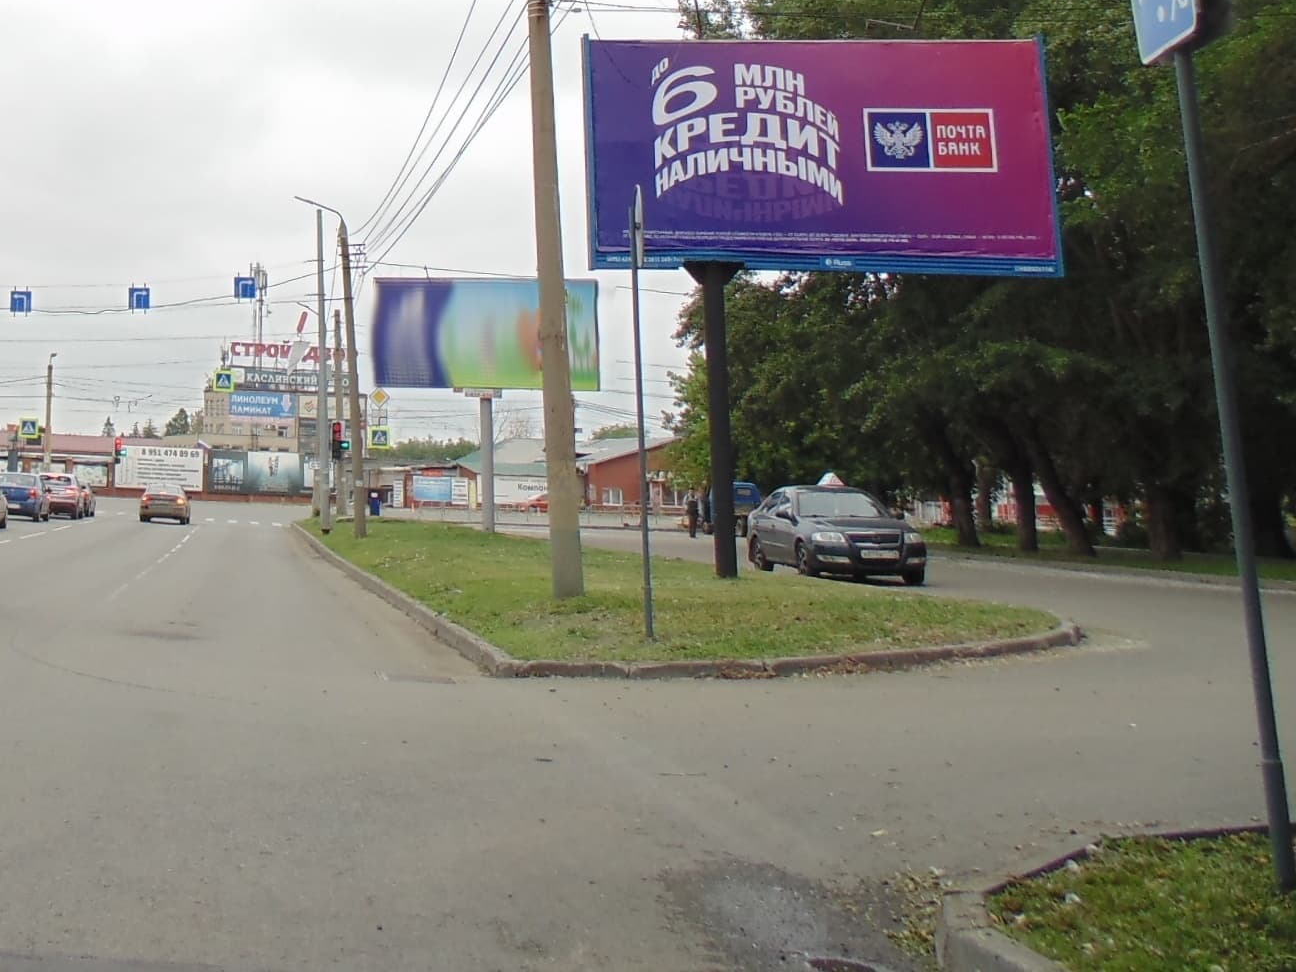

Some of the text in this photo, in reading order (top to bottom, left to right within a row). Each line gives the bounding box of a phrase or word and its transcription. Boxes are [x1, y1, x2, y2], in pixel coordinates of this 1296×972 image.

[651, 57, 669, 86] ДО
[734, 63, 805, 96] МЛН
[652, 65, 718, 126] 6
[735, 86, 840, 142] РУБЛЕЙ
[654, 112, 841, 170] КРЕДИТ
[936, 124, 986, 139] ПОЧТА
[937, 141, 981, 156] БАНК
[655, 147, 843, 206] НАЛИЧНЫМИ
[230, 340, 293, 359] СТРОЙ
[231, 394, 279, 405] ЛИНОЛЕУМ
[231, 405, 272, 415] ЛАМИНАТ
